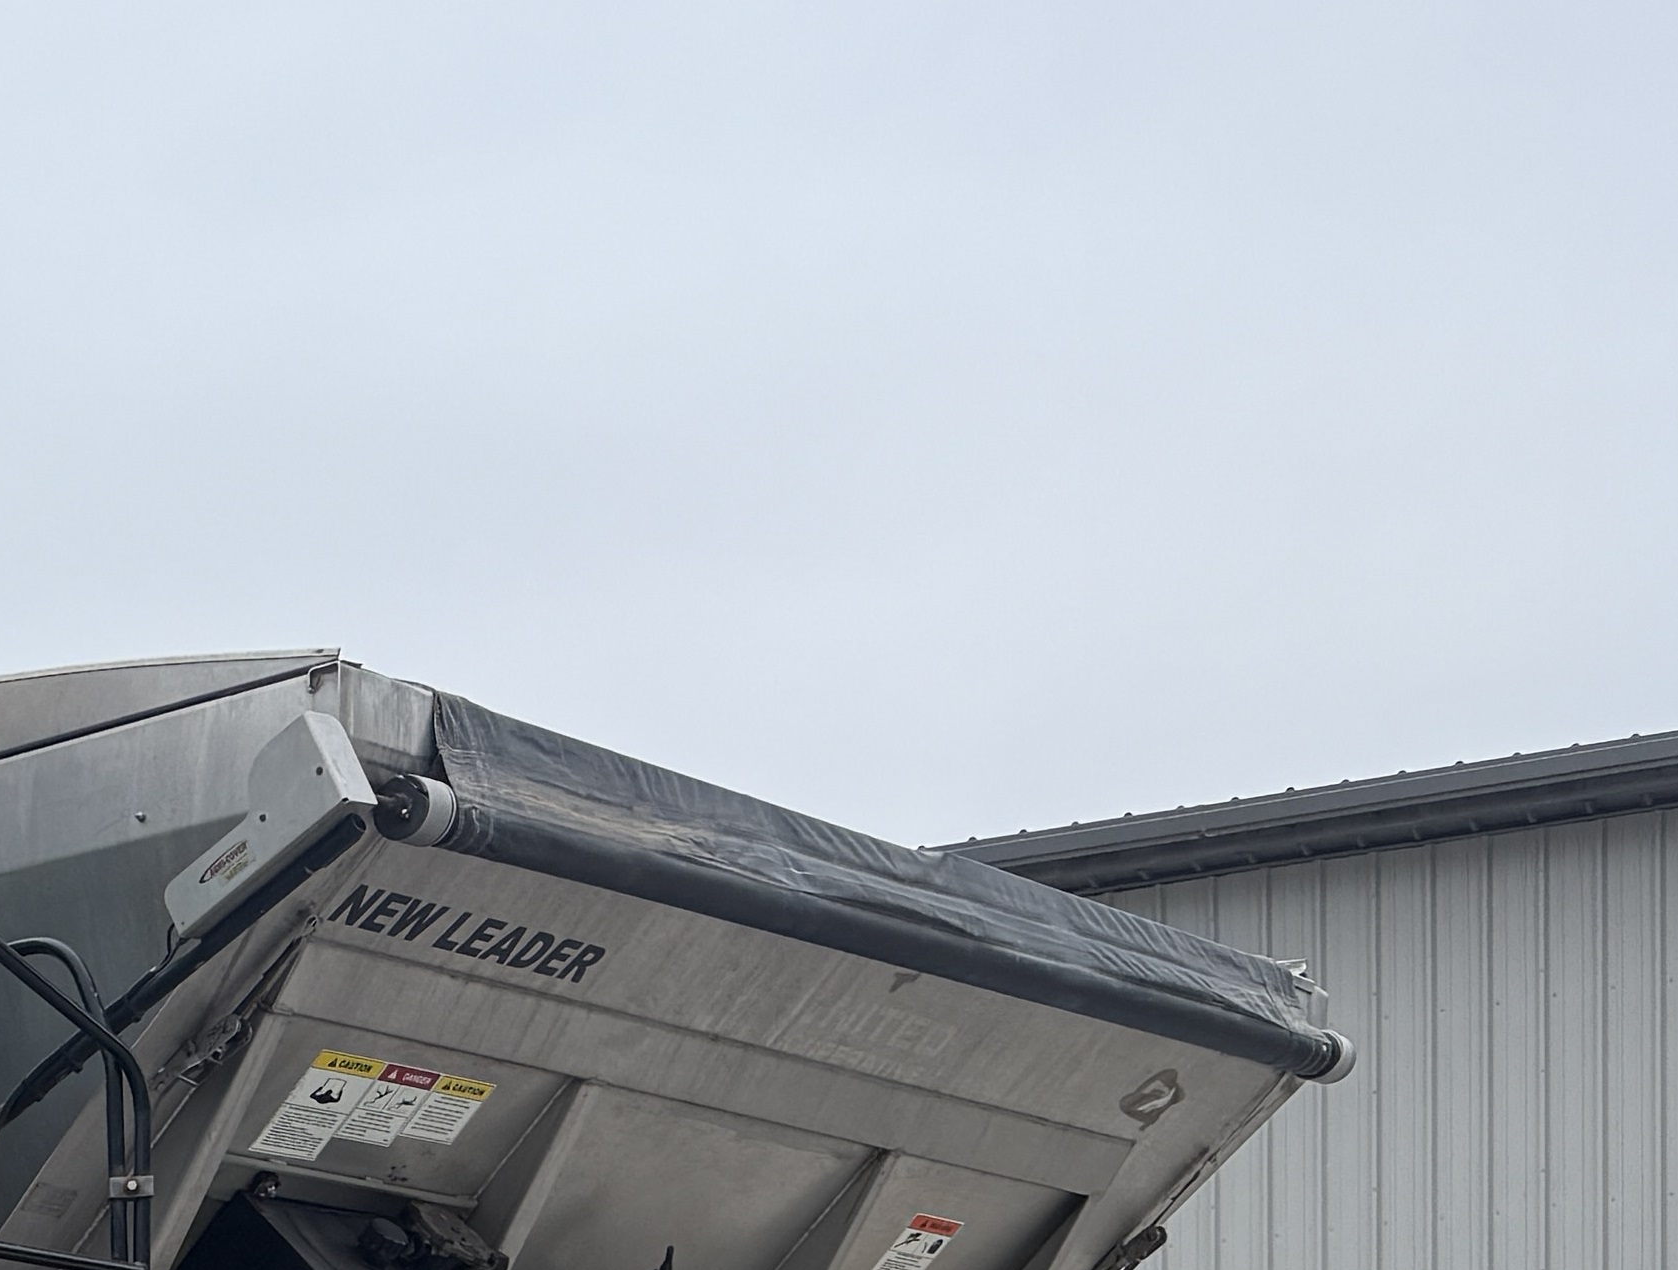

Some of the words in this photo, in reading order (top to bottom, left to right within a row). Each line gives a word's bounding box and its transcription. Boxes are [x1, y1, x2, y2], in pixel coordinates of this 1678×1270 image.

[328, 884, 449, 942] NEW
[432, 911, 606, 983] LEADER
[338, 1058, 373, 1073] CAUTION
[452, 1084, 486, 1096] CAUTION
